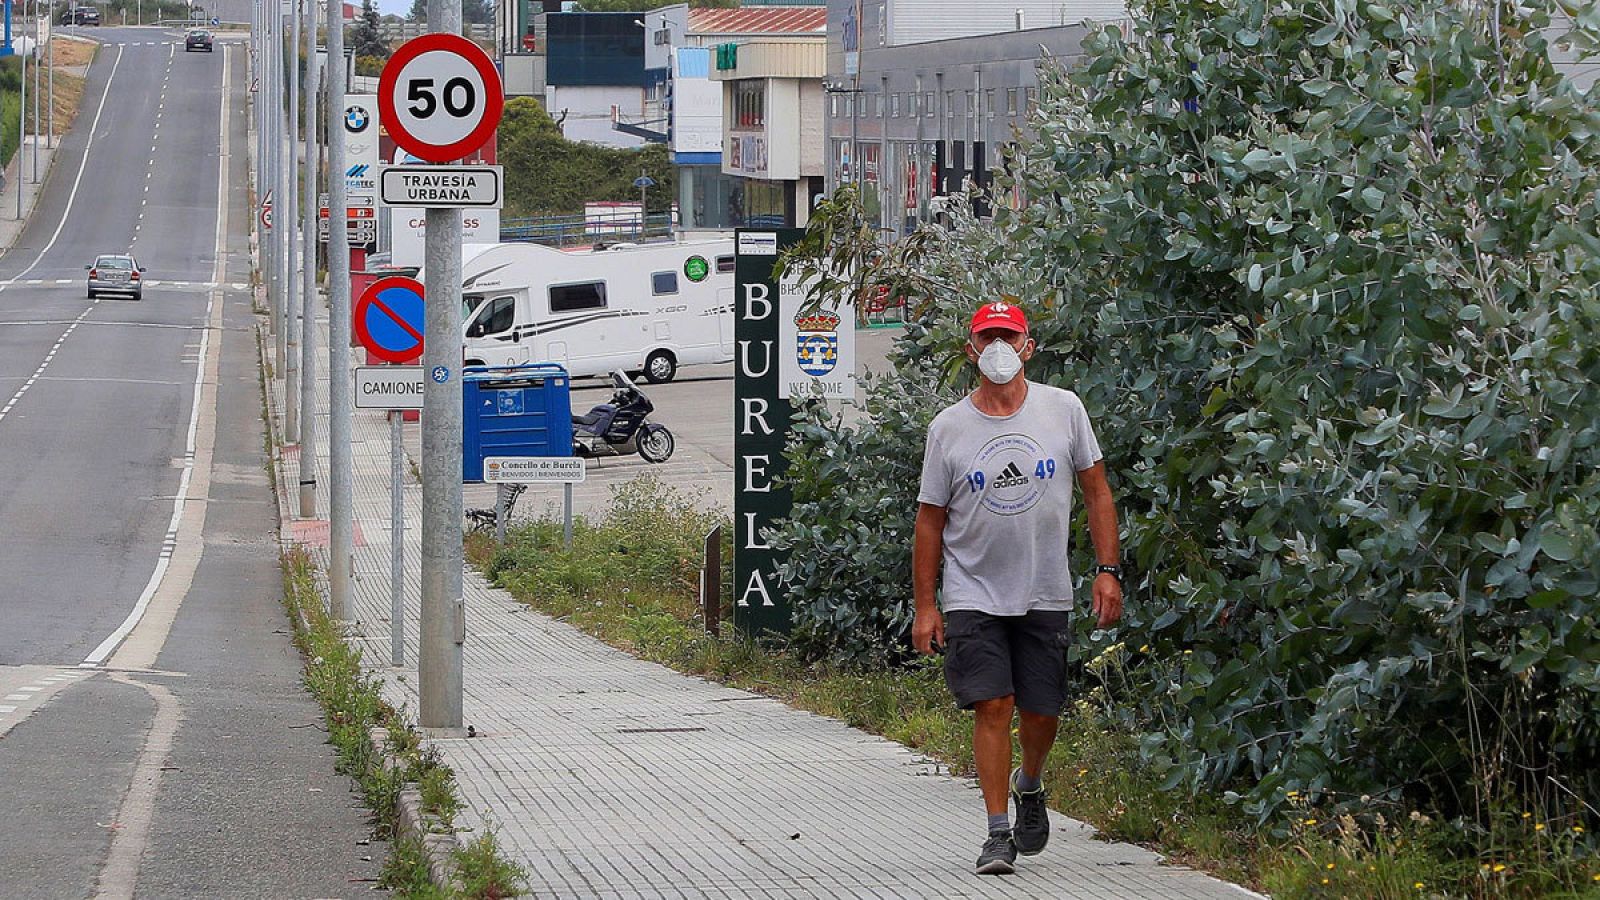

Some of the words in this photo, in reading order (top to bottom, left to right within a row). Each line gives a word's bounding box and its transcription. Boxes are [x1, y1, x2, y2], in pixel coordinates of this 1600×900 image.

[408, 77, 476, 119] 50
[402, 173, 476, 187] TRAVESÍA
[407, 188, 471, 200] URBANA
[655, 304, 688, 314] XGO
[363, 382, 424, 395] CAMIONE
[788, 382, 843, 394] WELOME
[738, 283, 775, 606] BURELA
[1034, 458, 1056, 479] 49
[966, 471, 985, 493] 19
[992, 476, 1029, 489] adidas
